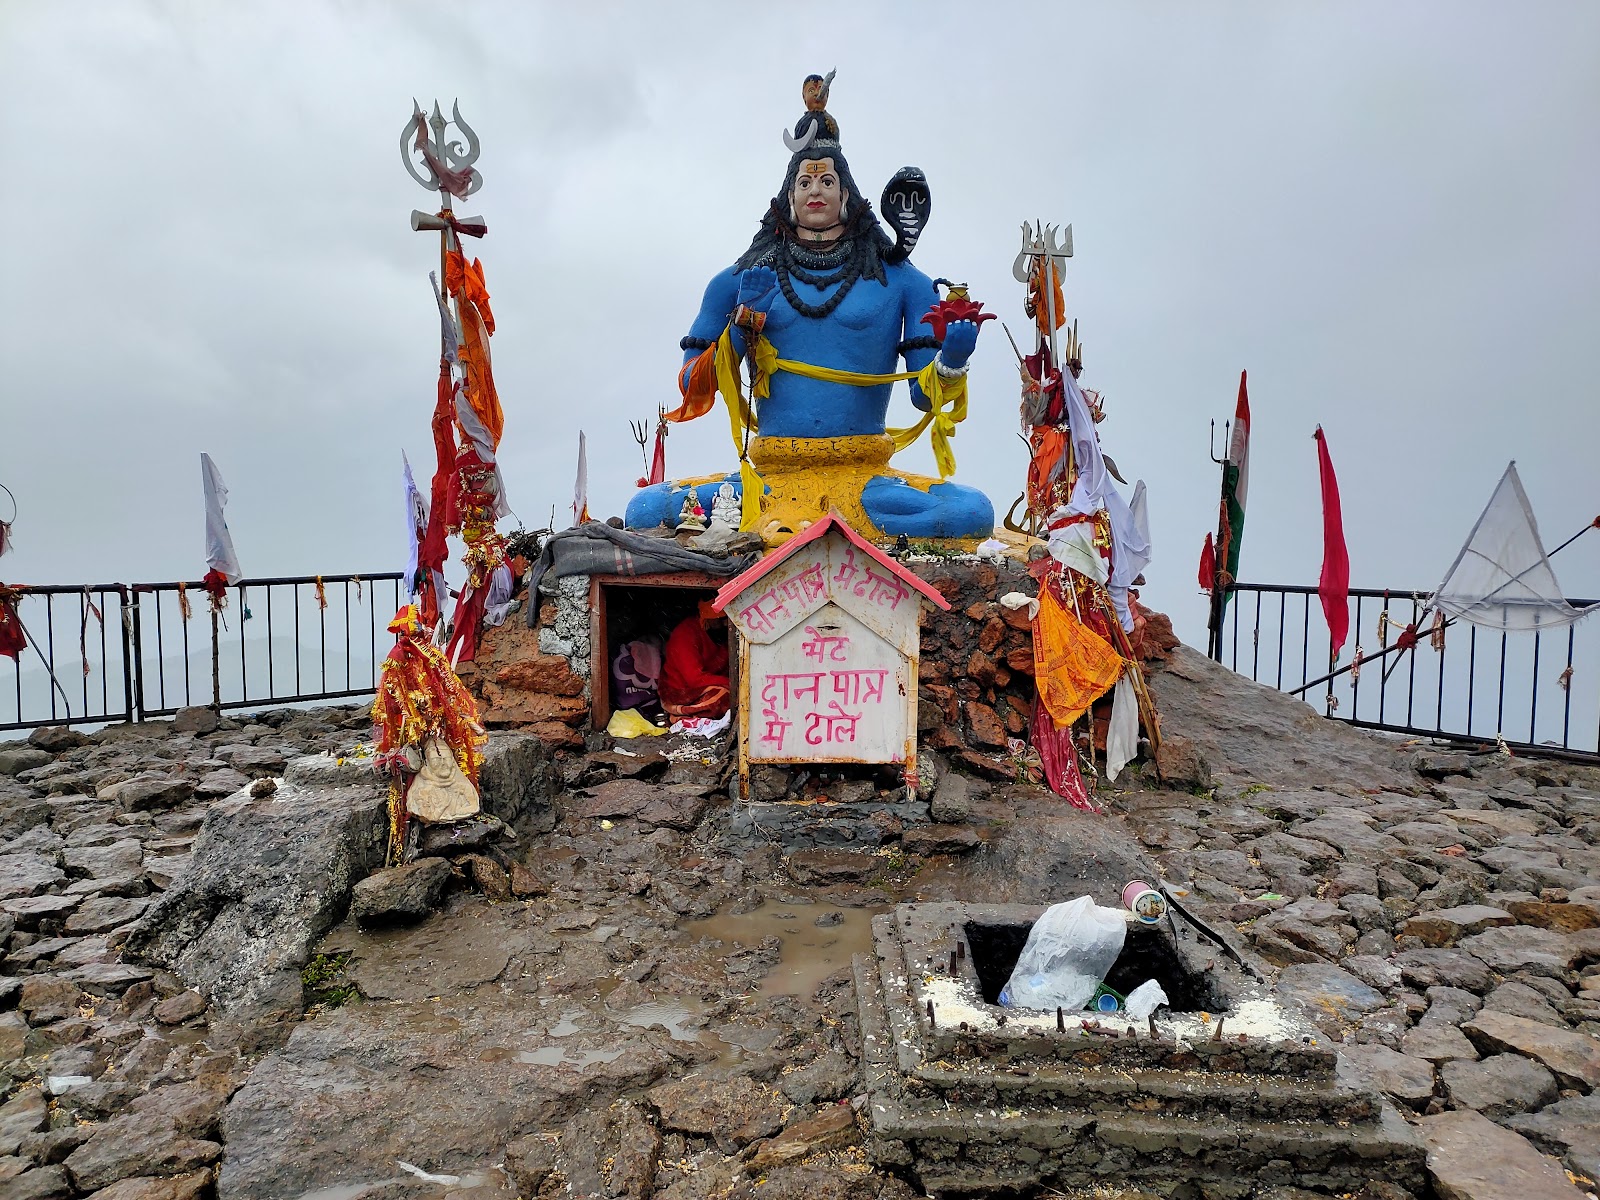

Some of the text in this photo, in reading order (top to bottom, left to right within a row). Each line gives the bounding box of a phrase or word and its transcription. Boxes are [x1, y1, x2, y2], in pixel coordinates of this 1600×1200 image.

[739, 588, 792, 634] दान
[762, 669, 889, 710] दान पात्र
